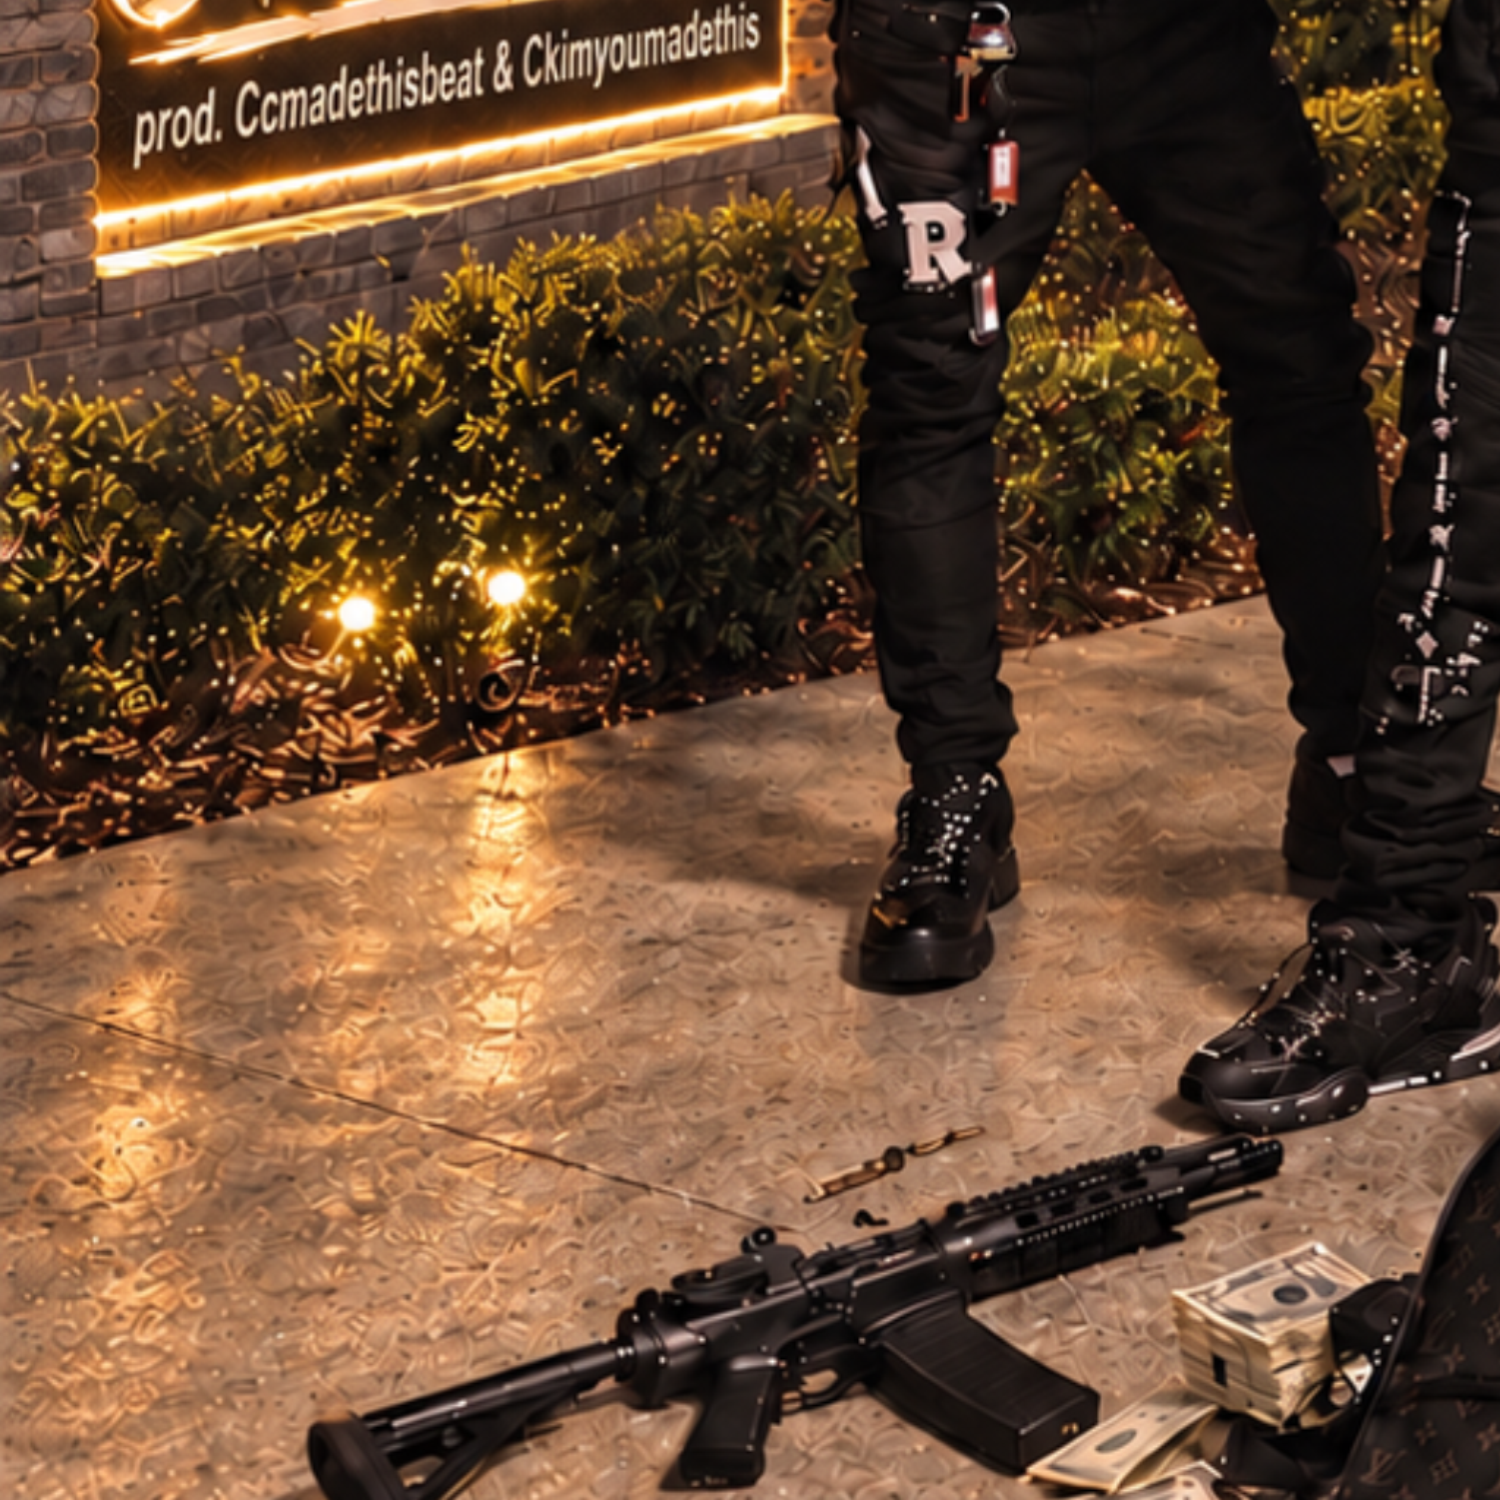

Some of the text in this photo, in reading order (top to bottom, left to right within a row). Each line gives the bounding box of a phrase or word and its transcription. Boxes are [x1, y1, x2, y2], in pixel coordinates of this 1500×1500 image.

[133, 1, 761, 170] prod. Ccmadethisbeat & Ckimyoumadethis
